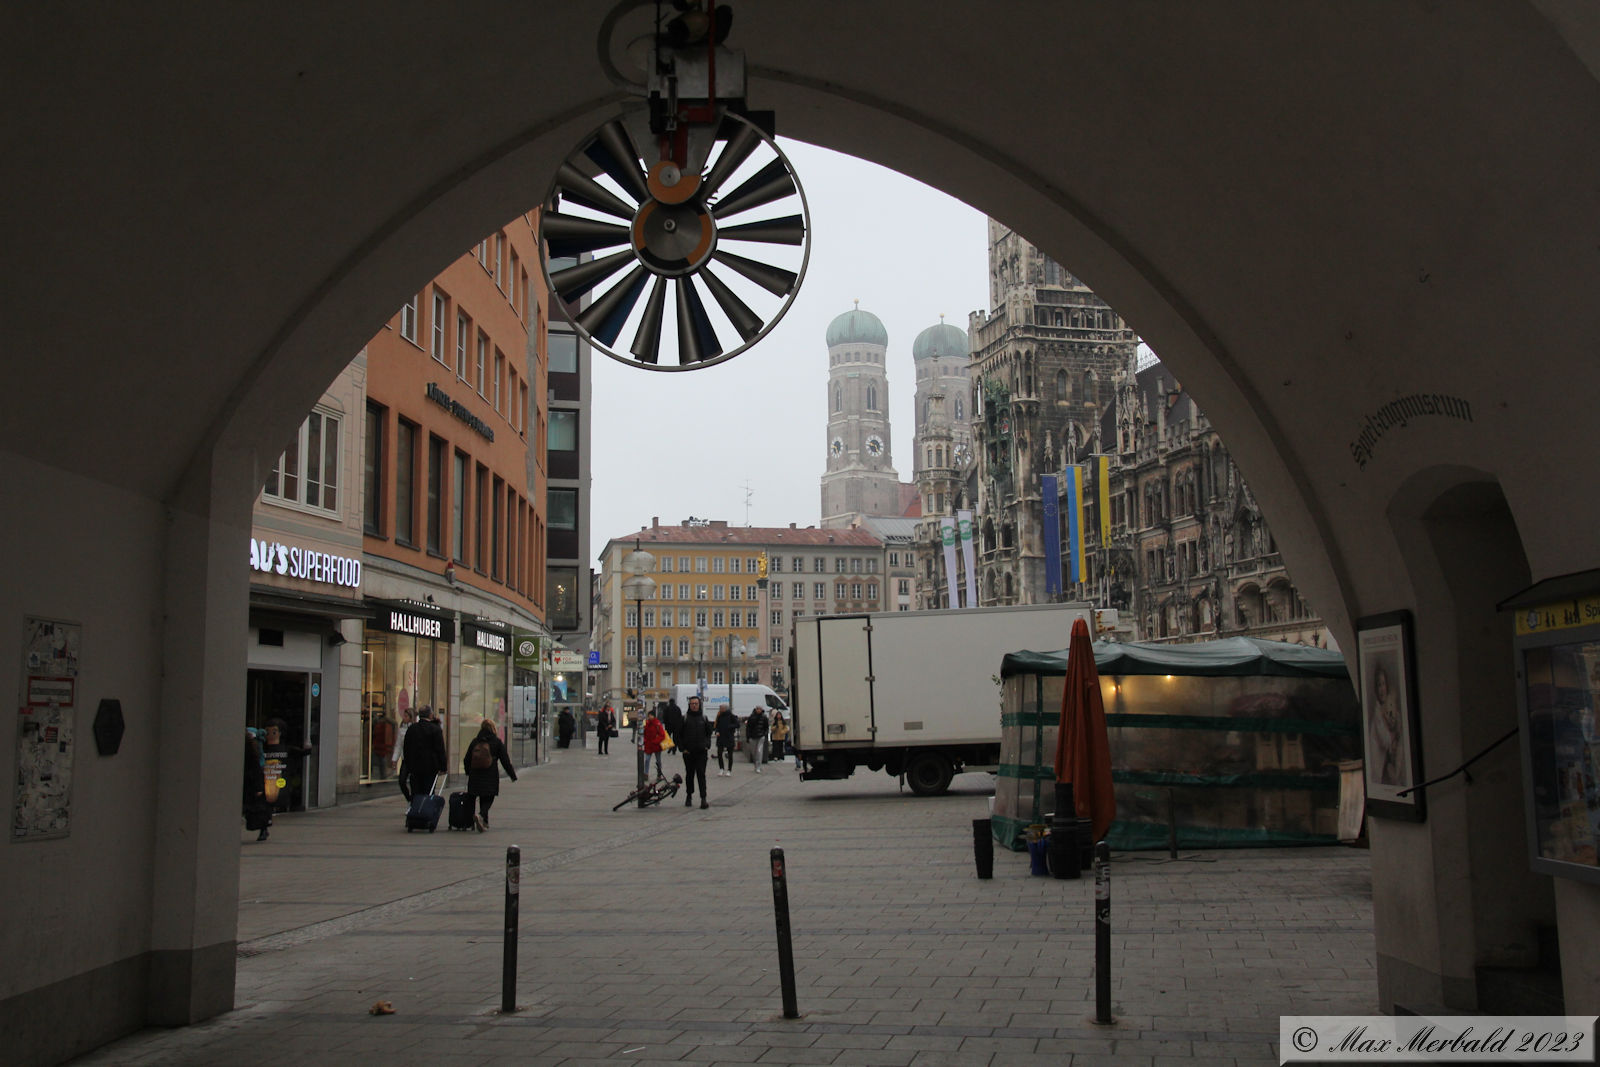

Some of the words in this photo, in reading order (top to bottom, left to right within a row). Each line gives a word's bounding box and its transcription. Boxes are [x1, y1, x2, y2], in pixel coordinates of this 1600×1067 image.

[290, 546, 361, 588] SUPERFOOD
[390, 611, 441, 639] HALLHUBER
[476, 630, 505, 652] HALLHUBER
